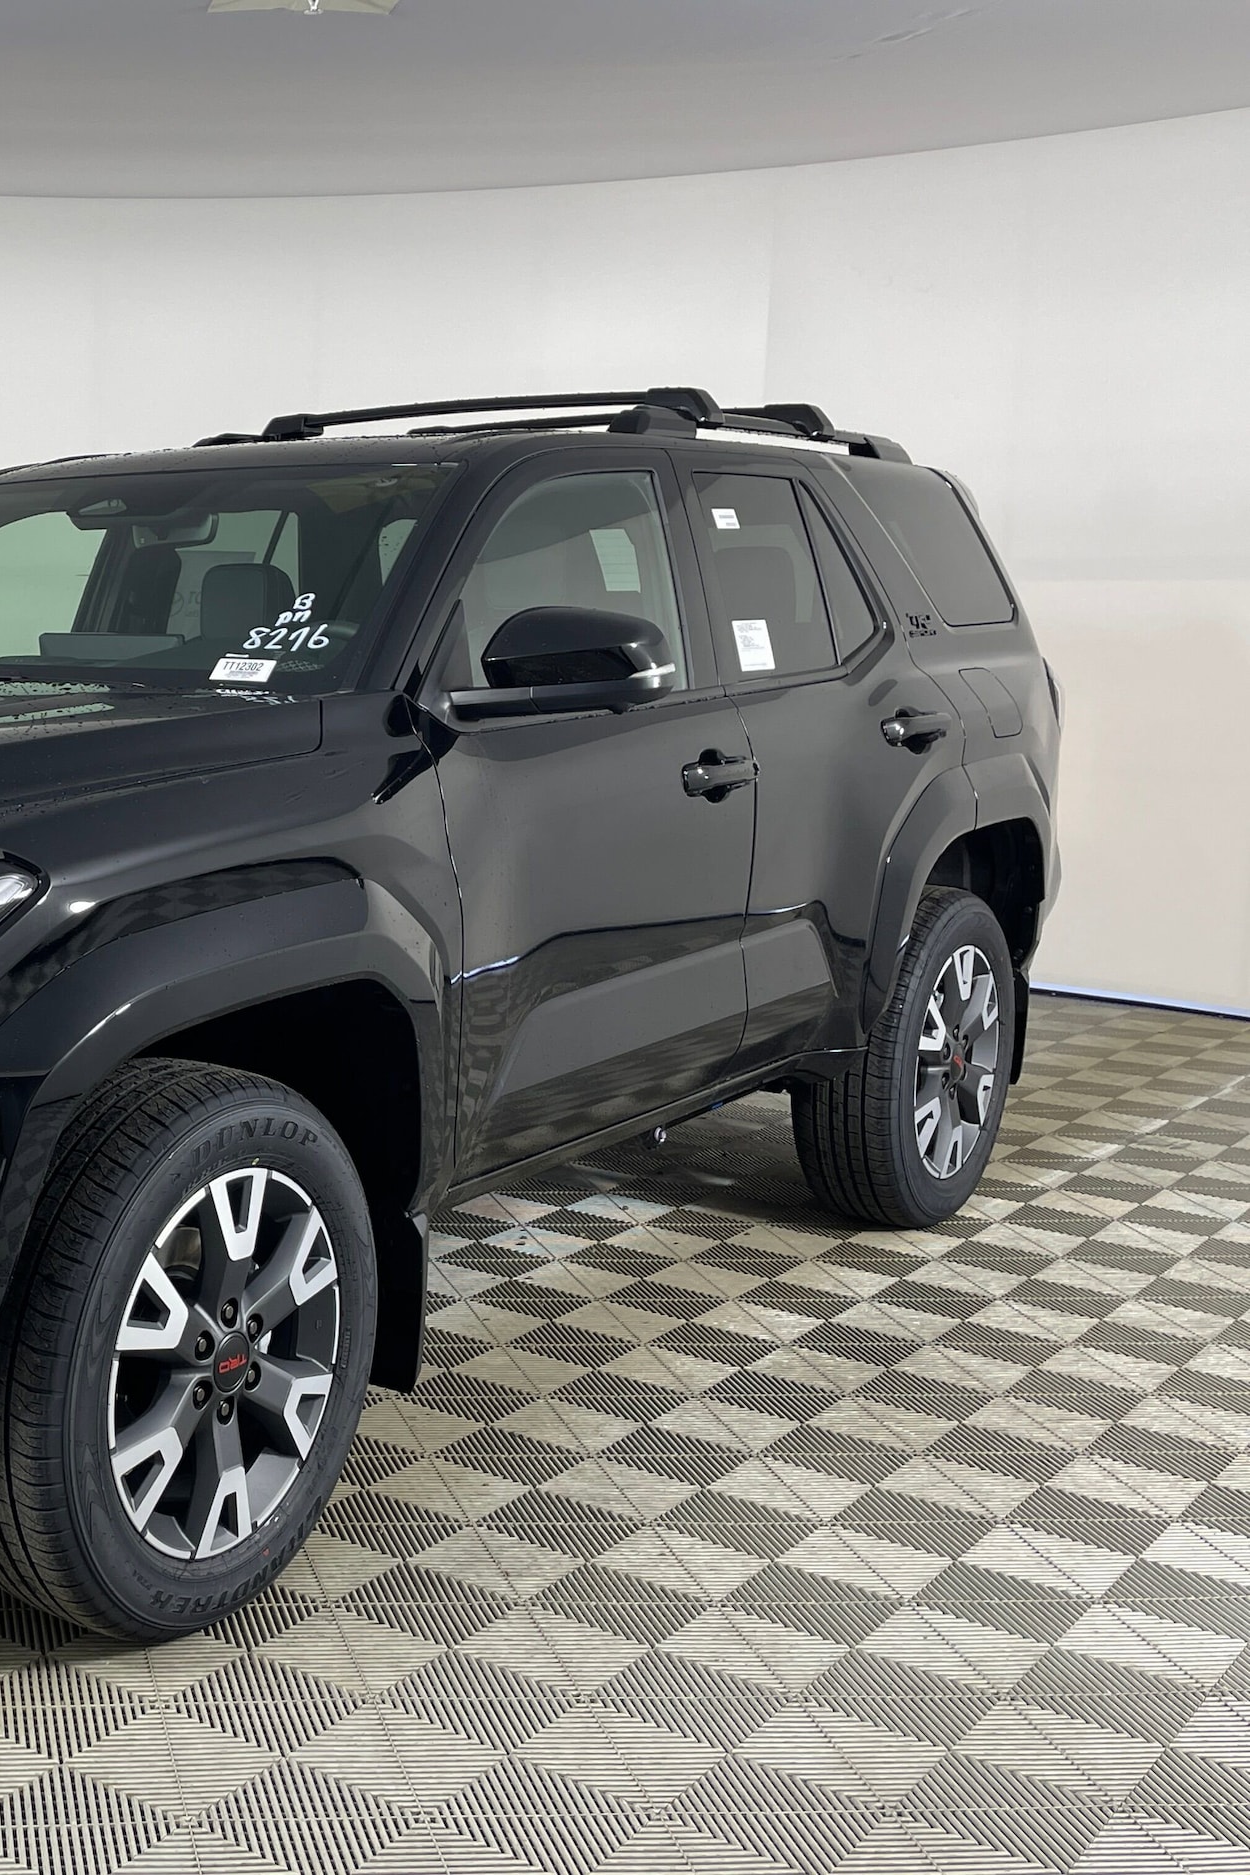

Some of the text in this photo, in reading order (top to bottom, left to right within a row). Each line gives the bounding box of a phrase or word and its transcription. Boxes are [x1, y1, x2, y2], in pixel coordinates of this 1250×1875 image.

[222, 661, 265, 672] TT12302
[190, 1117, 319, 1168] DUNLOP
[219, 1354, 247, 1373] TRD
